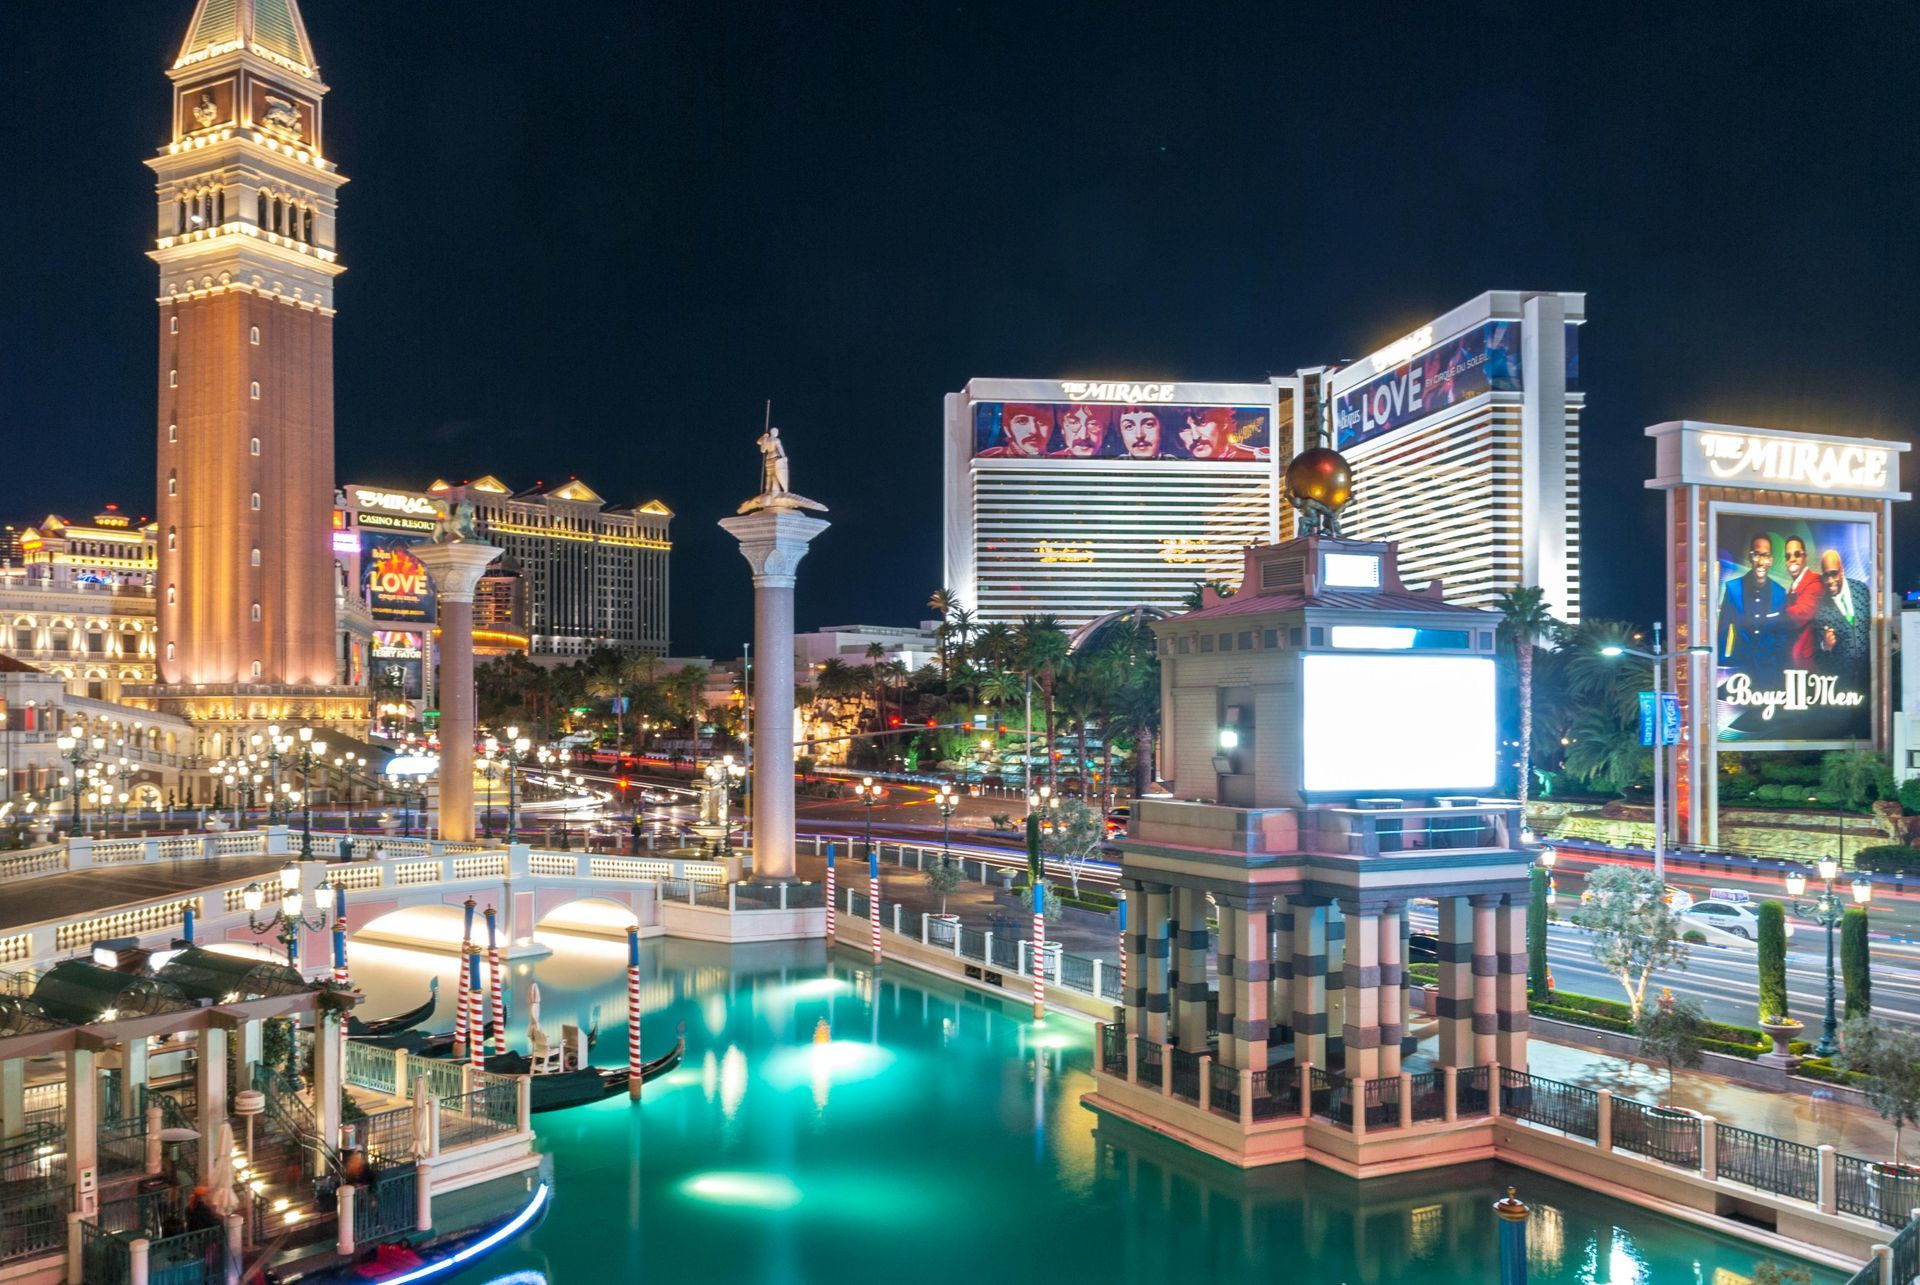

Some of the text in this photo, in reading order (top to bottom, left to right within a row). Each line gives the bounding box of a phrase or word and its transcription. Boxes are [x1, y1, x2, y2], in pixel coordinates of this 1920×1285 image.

[1061, 382, 1175, 403] THE MIRAGE
[1362, 367, 1423, 432] LOVE
[1700, 434, 1888, 489] THE MIRAGE
[359, 514, 435, 531] CASINO & RESORT
[370, 571, 429, 595] LOVE
[1725, 669, 1865, 720] Boyz II Men
